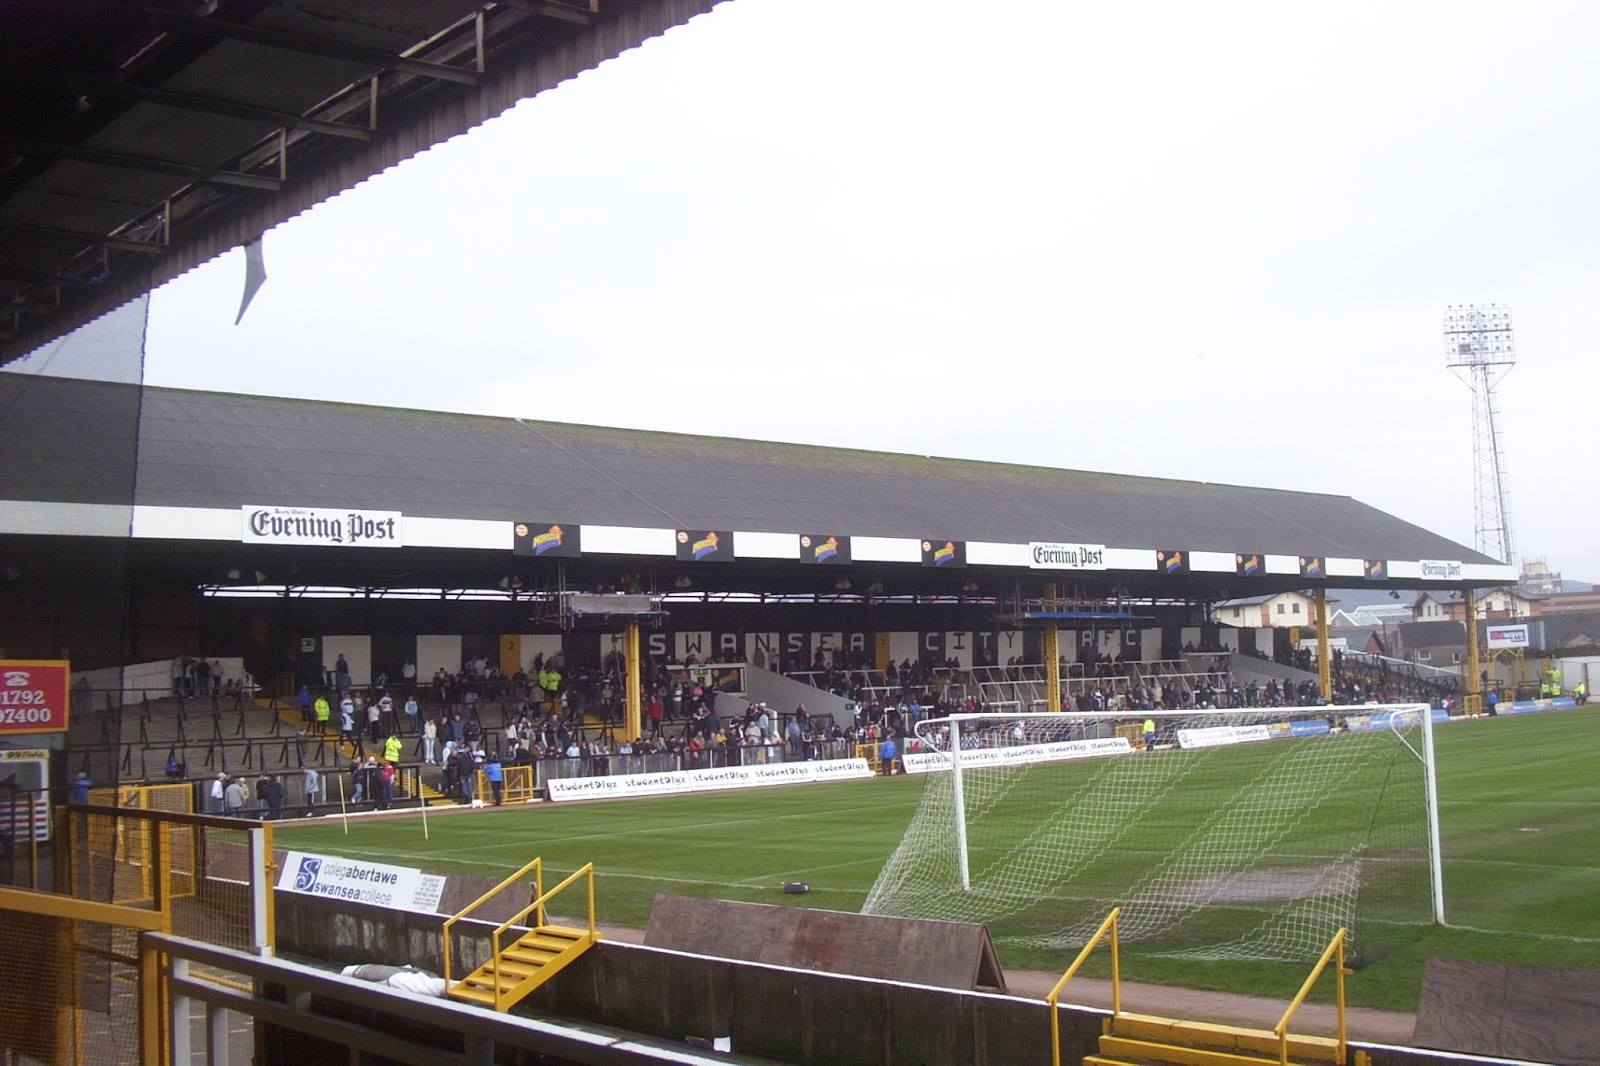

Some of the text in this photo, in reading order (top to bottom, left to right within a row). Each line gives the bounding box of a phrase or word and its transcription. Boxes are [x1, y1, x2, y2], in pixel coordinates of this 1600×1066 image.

[250, 509, 395, 543] Evening Post
[1033, 545, 1103, 567] Evening Post
[649, 632, 865, 655] SWANSEA
[925, 630, 1016, 651] CITY
[0, 690, 45, 705] 1792
